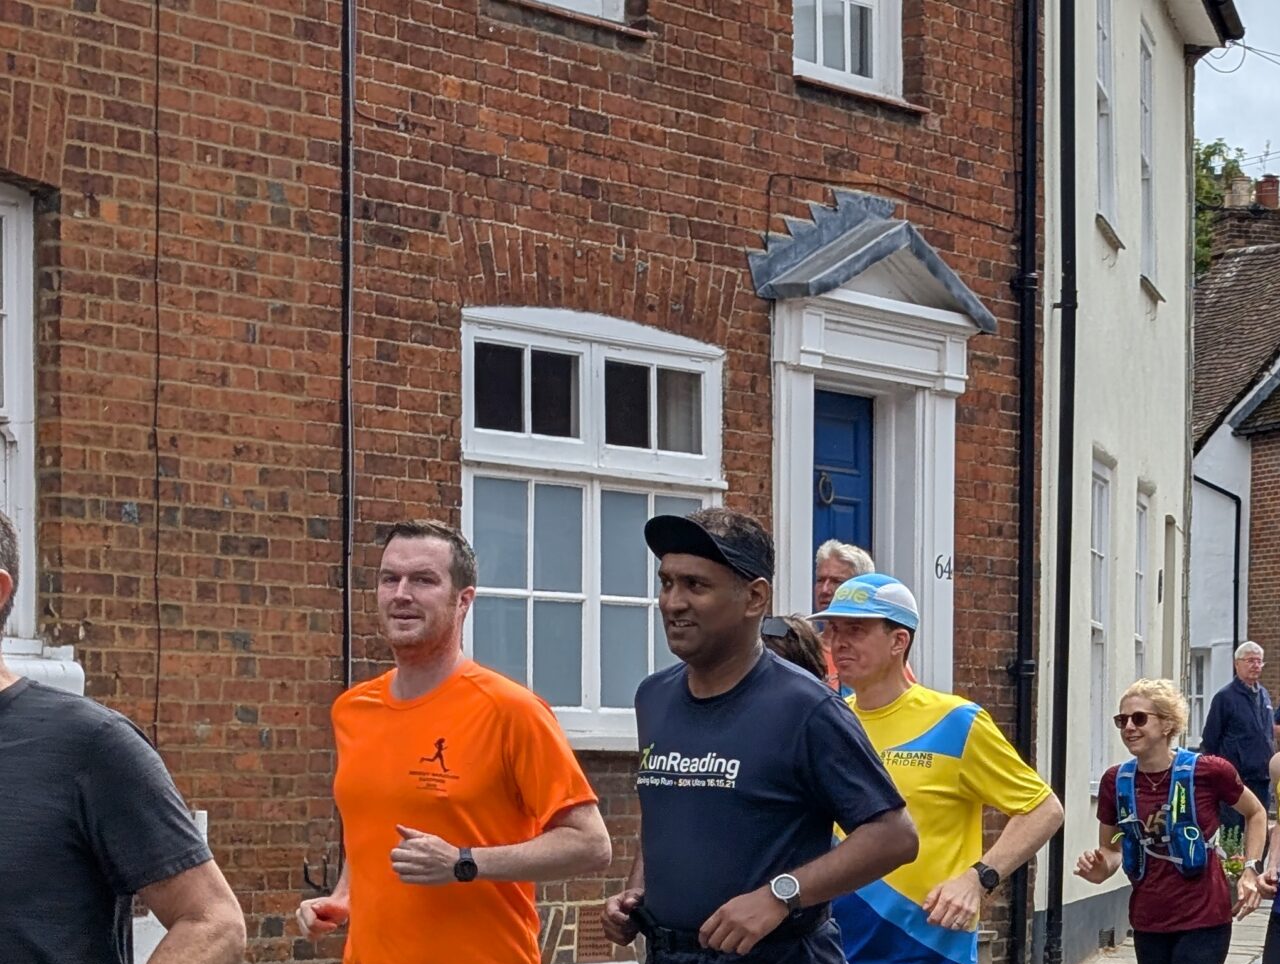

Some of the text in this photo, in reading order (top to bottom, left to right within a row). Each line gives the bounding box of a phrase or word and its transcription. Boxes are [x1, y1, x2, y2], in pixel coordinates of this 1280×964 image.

[935, 554, 952, 580] 64
[640, 743, 740, 779] RunReading
[884, 758, 933, 768] TRIDERS
[893, 752, 933, 761] ALBANS
